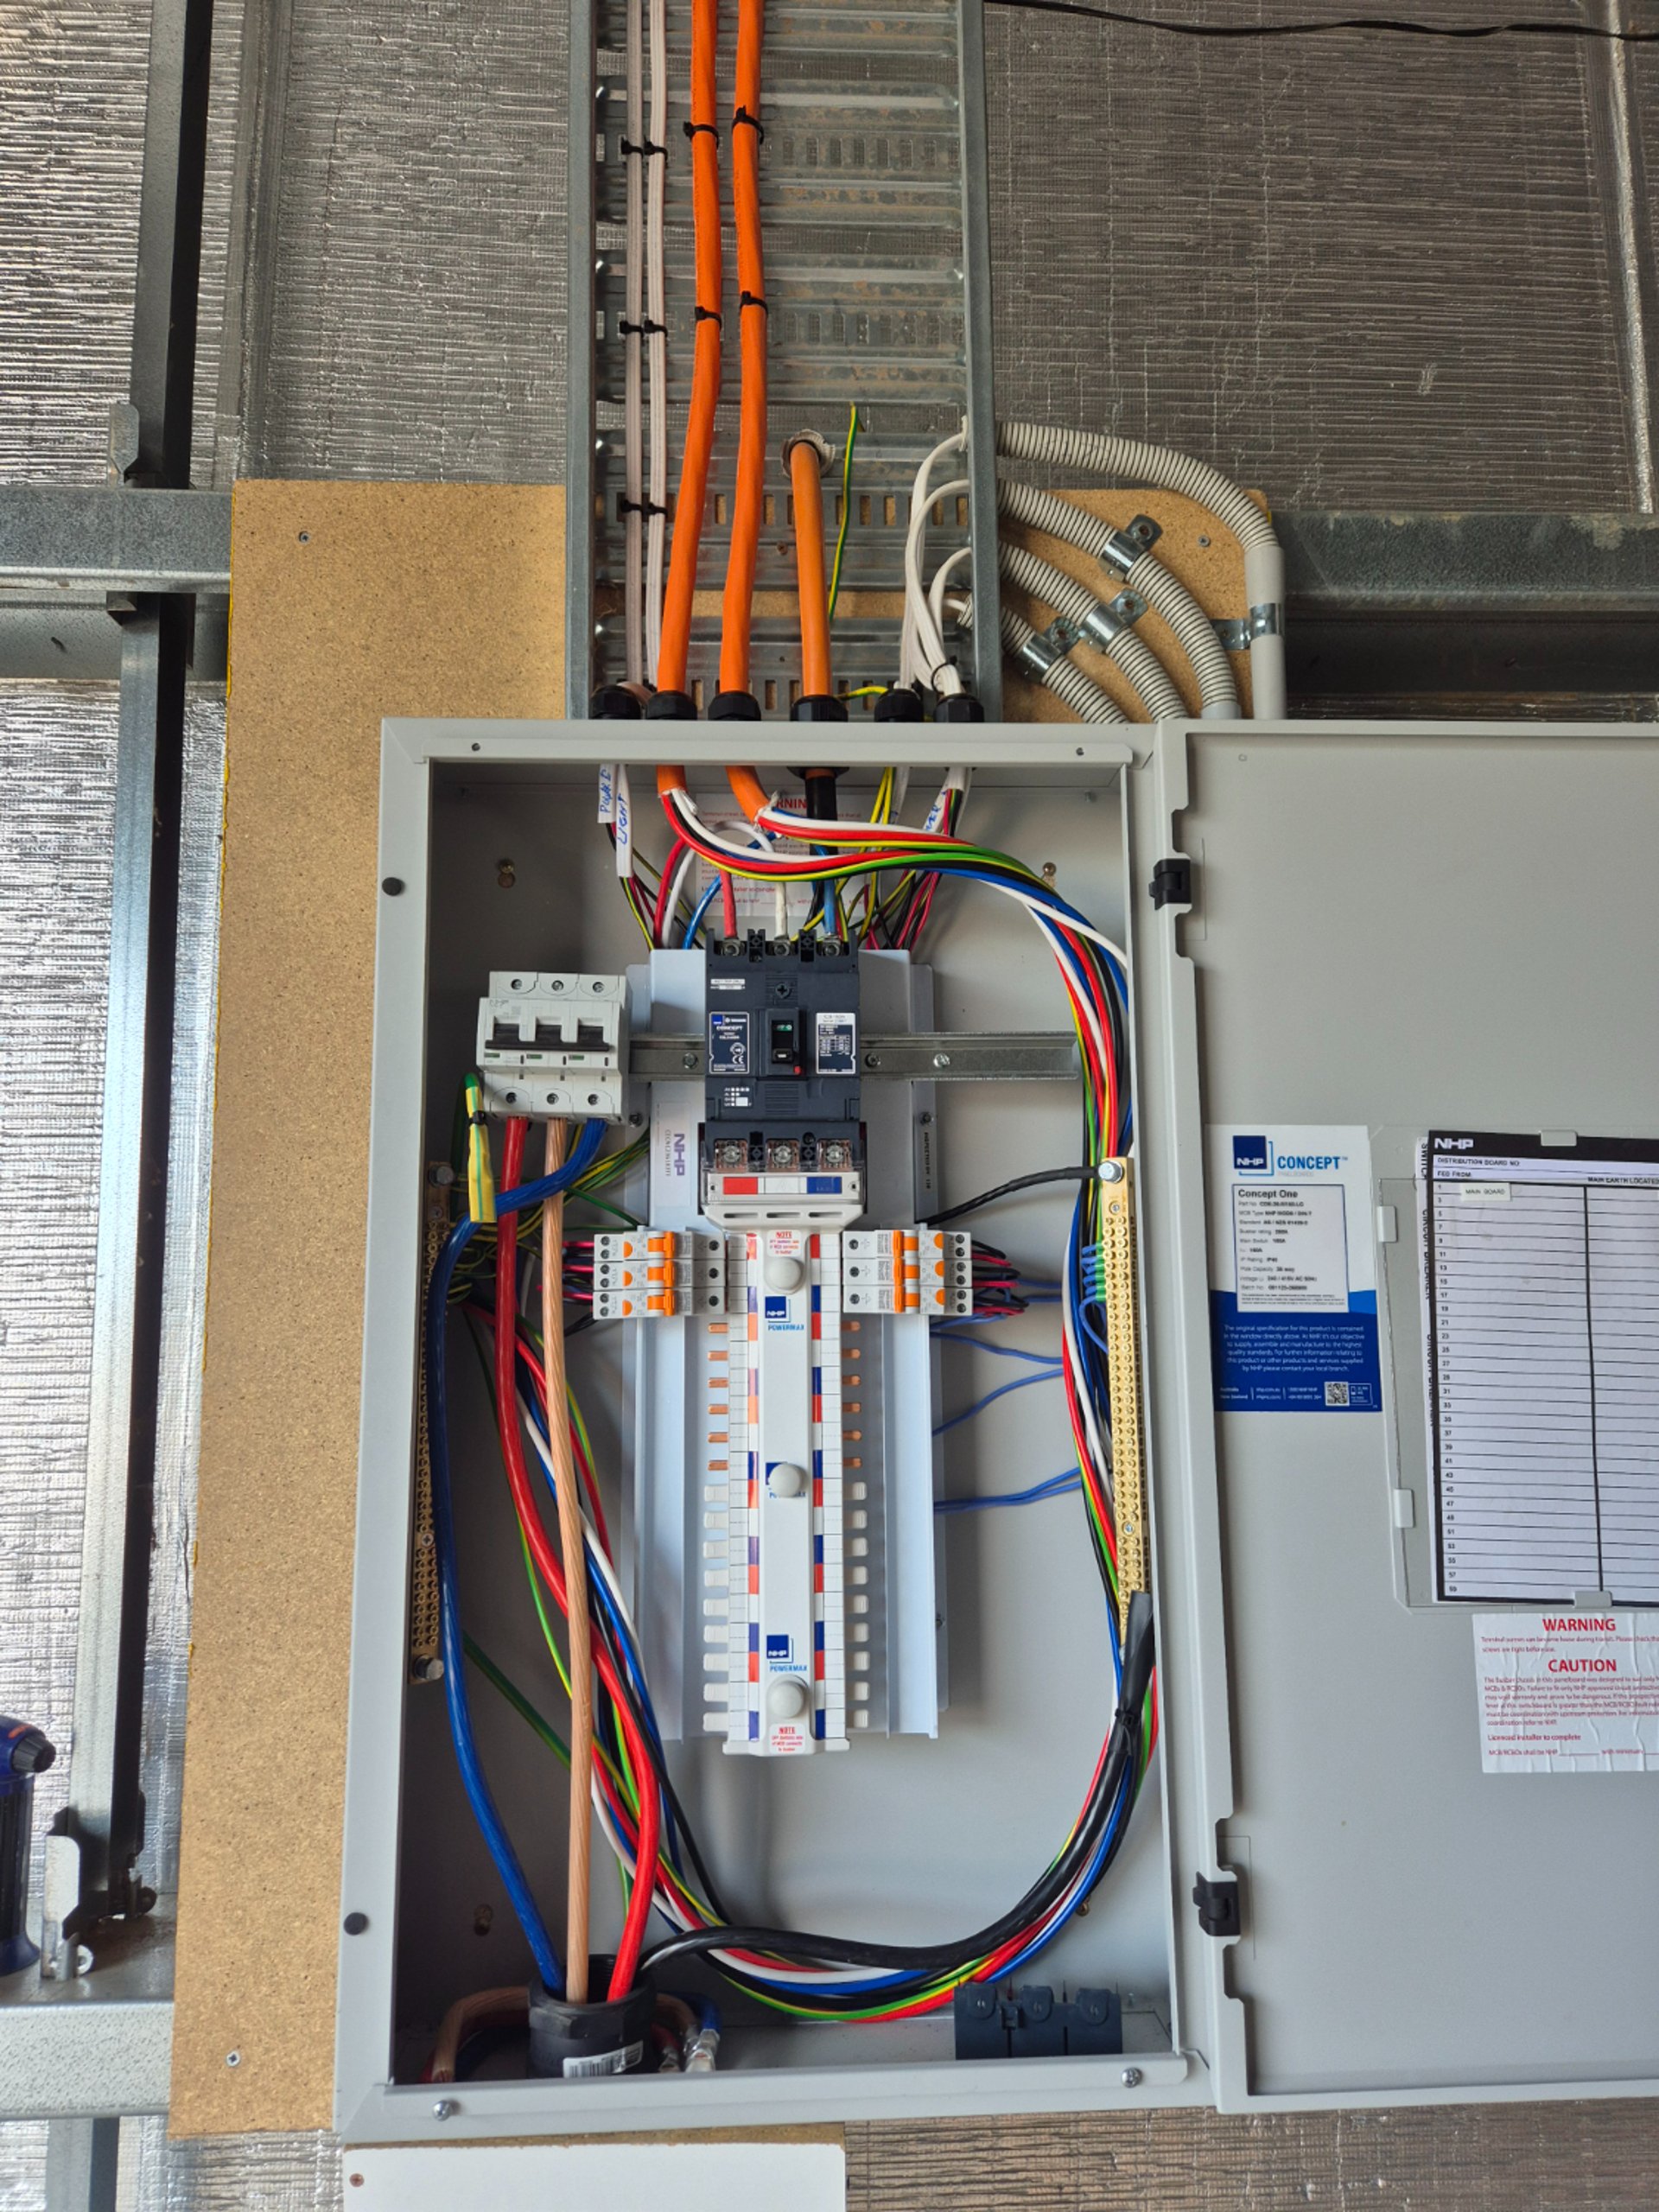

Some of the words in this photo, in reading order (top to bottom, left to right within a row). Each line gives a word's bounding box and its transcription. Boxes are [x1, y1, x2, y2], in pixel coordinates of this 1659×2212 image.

[1434, 1138, 1474, 1149] NHP
[674, 1133, 685, 1176] NHP
[1236, 1157, 1264, 1166] NHP
[1237, 1189, 1277, 1200] Concept
[1279, 1189, 1299, 1198] One
[1542, 1618, 1616, 1631] WARNING
[1548, 1659, 1617, 1672] CAUTION
